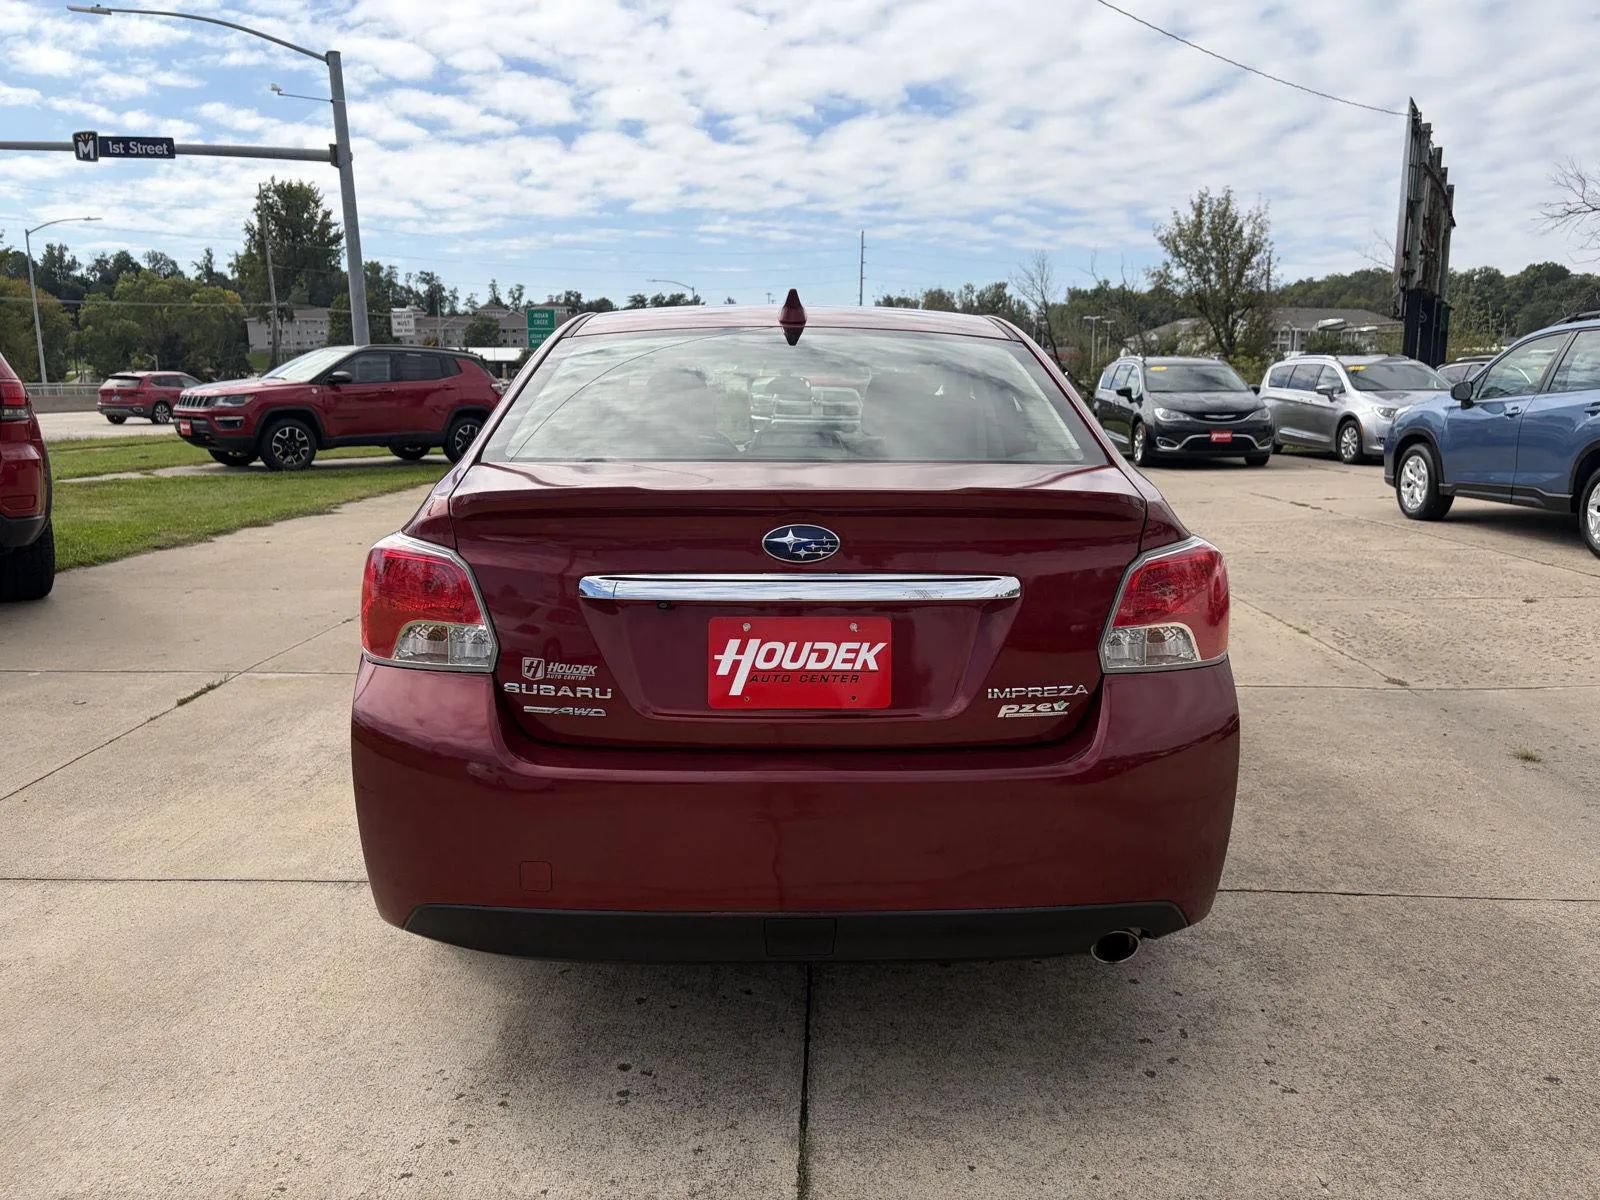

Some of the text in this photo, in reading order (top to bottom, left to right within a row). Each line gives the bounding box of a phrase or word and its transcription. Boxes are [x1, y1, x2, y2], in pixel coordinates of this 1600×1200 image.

[78, 140, 95, 160] M
[108, 140, 169, 155] 1st Street
[546, 662, 597, 675] HOUDEK
[714, 638, 888, 696] HOUDEK
[751, 674, 860, 683] AUTO CENTER
[503, 682, 612, 699] SUBARU
[987, 684, 1089, 699] IMPREZA
[554, 707, 607, 717] AWD
